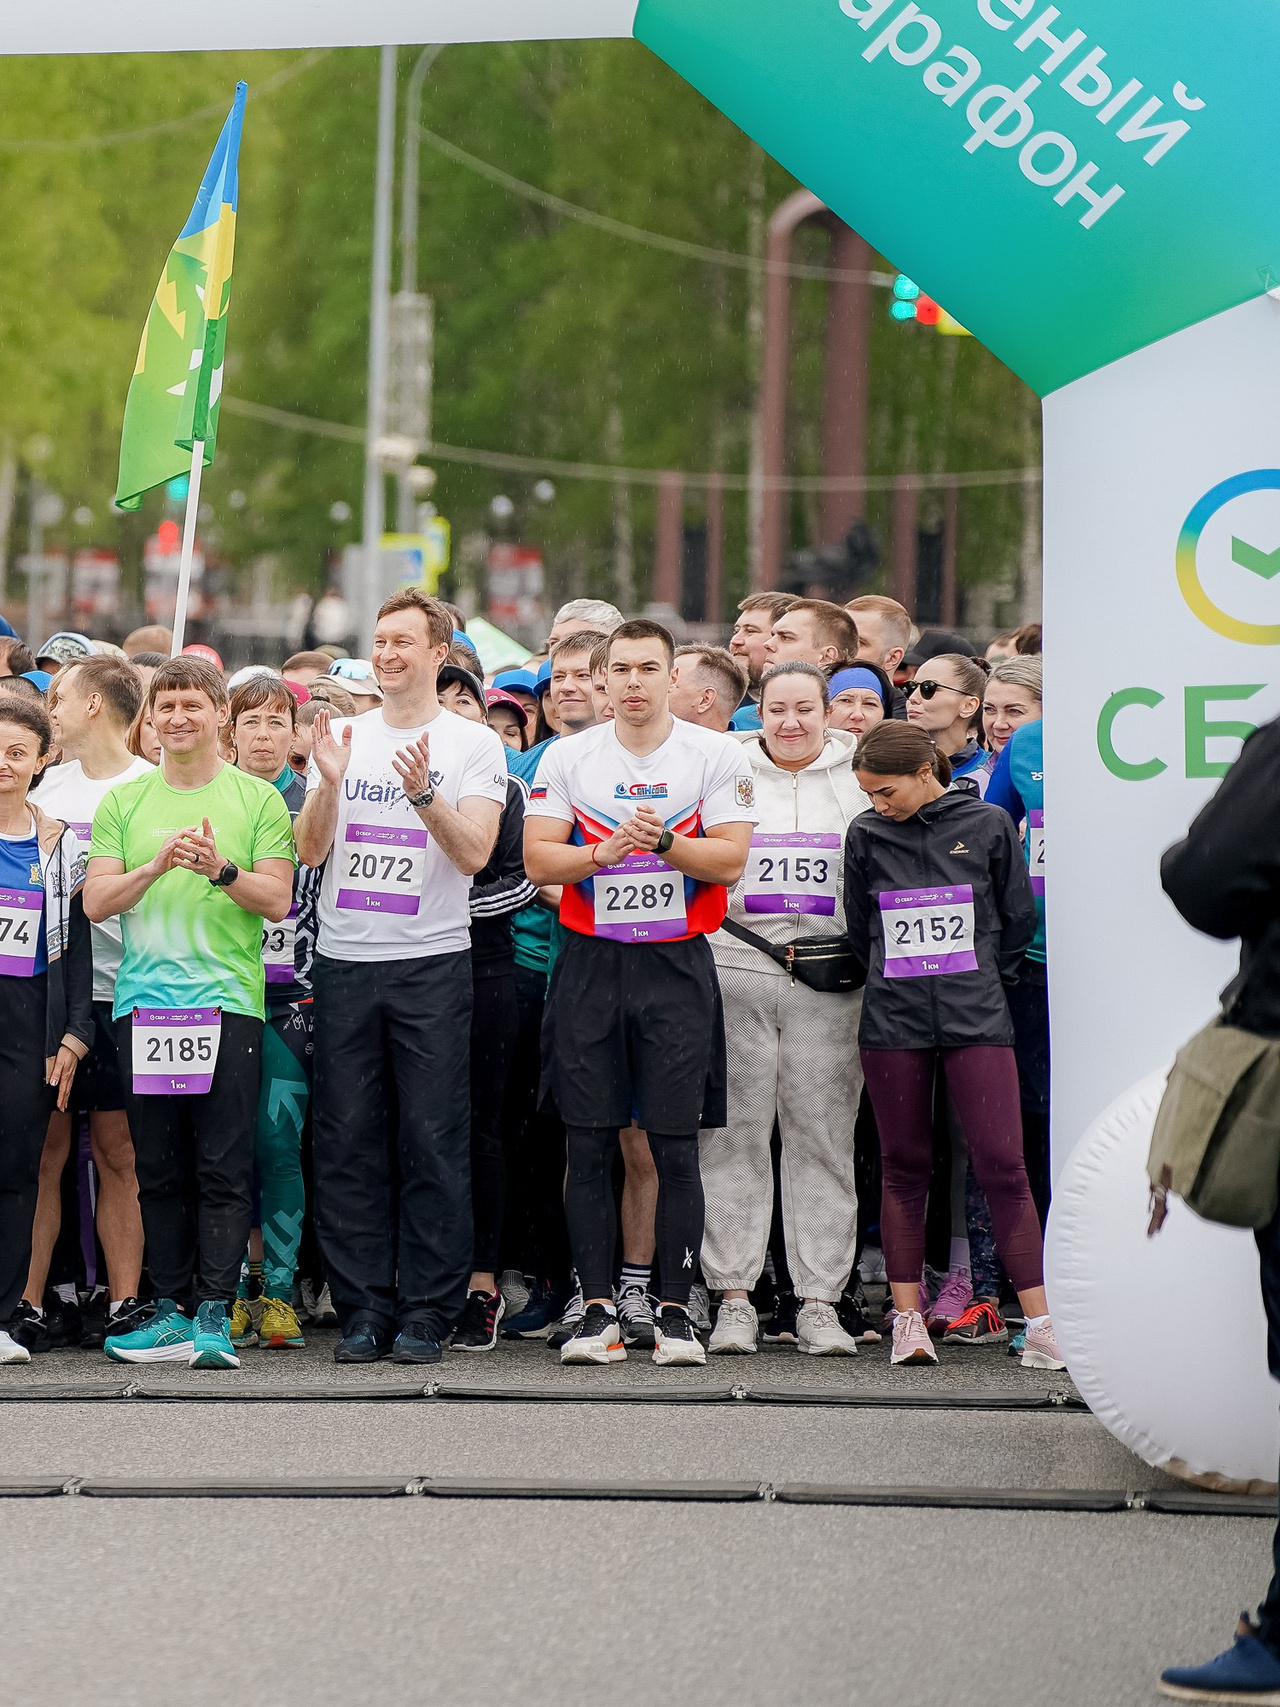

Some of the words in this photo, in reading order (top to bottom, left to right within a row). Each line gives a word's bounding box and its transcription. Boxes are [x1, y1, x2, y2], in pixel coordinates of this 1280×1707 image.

[345, 779, 401, 802] Utair
[349, 853, 413, 882] 2072
[758, 858, 828, 883] 2153
[606, 882, 674, 911] 2289
[895, 915, 964, 945] 2152
[146, 1036, 212, 1062] 2185
